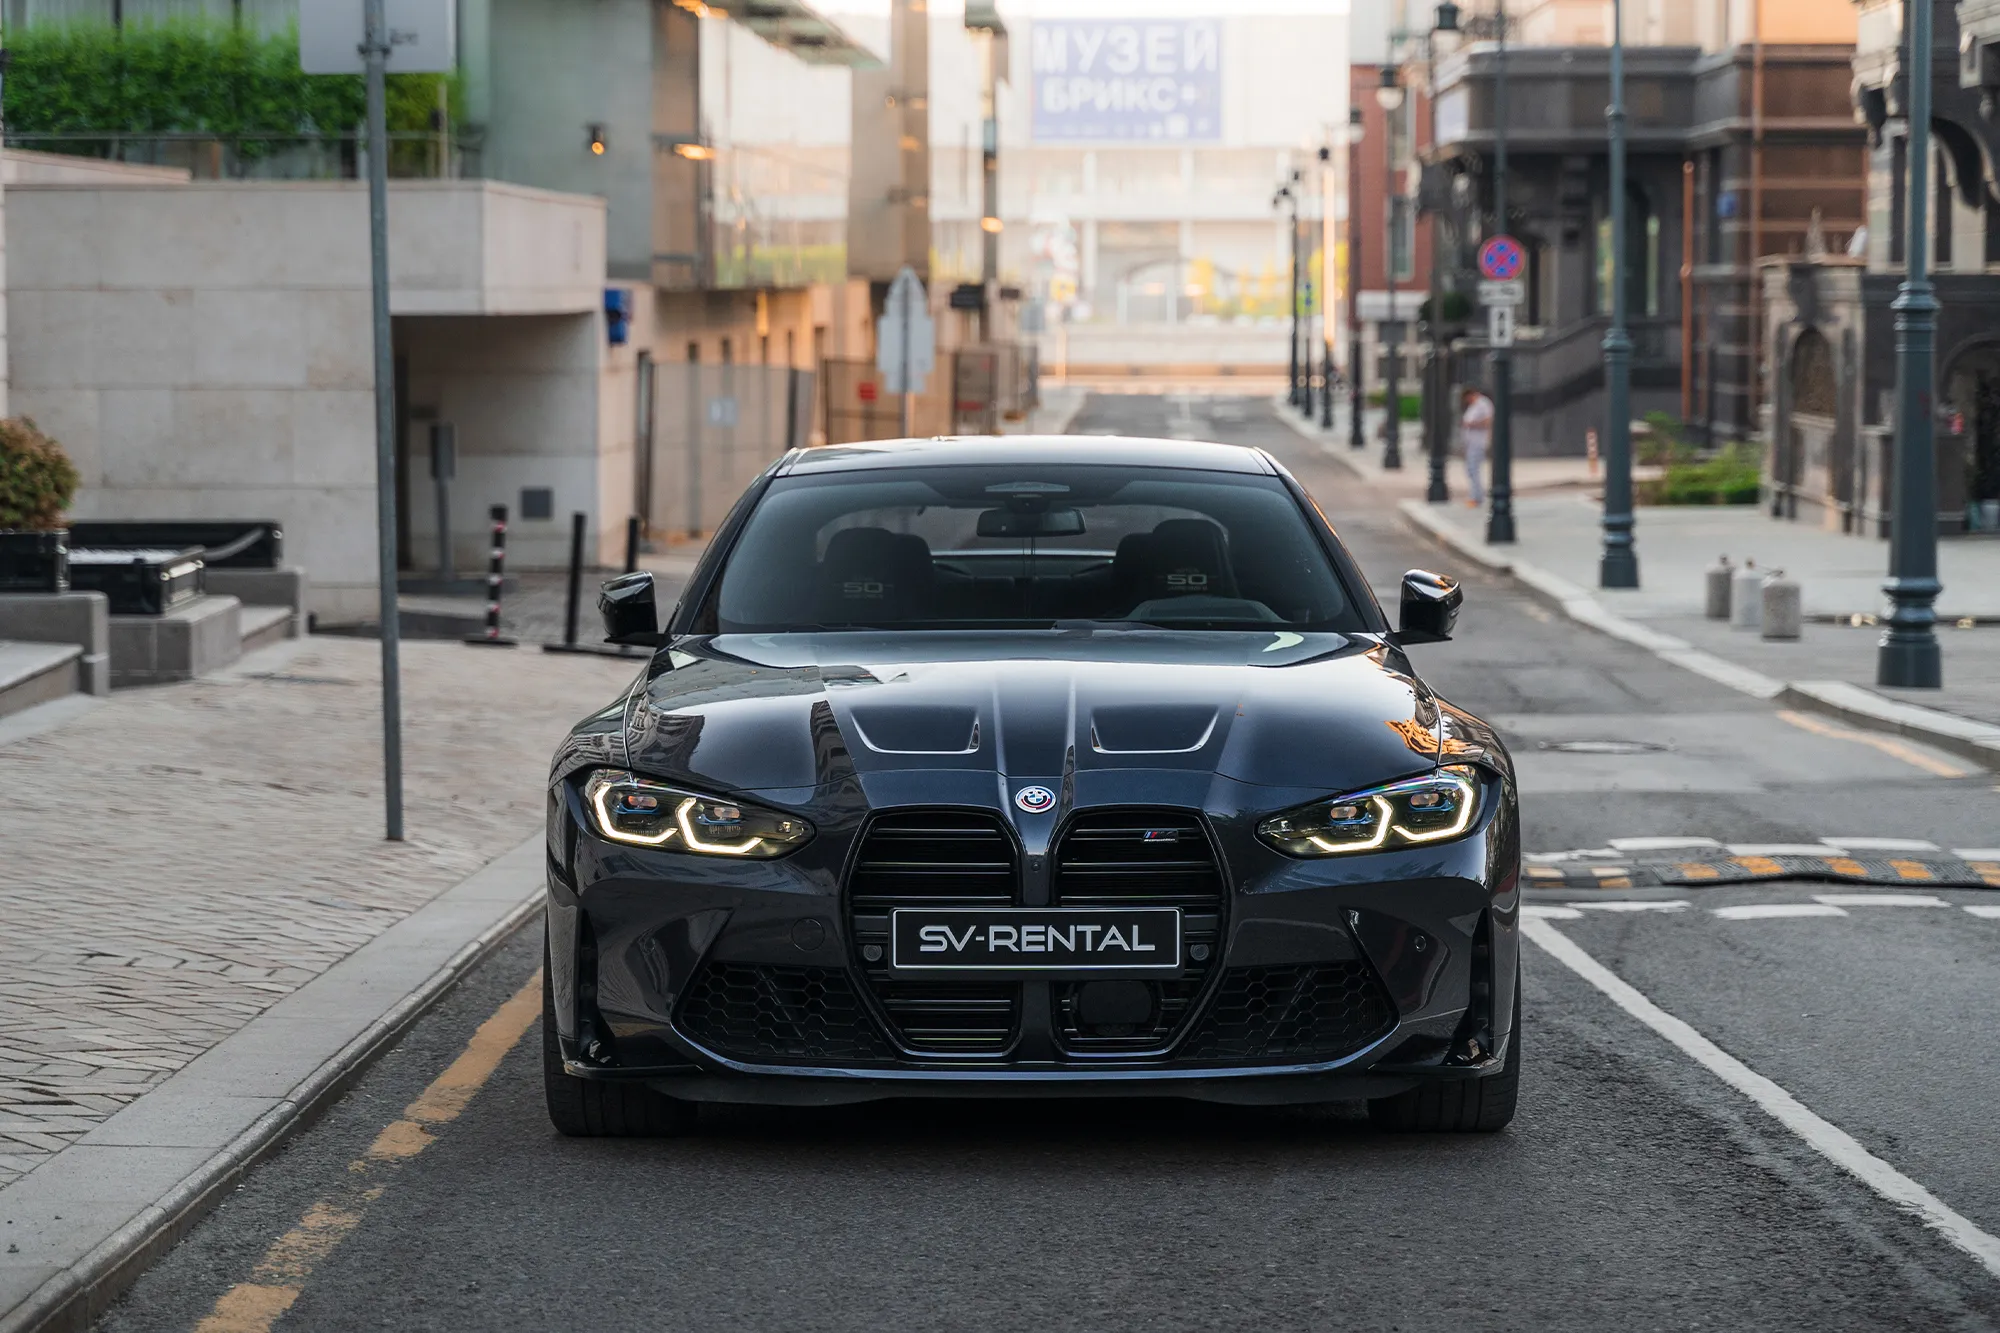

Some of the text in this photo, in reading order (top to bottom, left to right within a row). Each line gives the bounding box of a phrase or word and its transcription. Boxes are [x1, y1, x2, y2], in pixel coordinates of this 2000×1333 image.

[1033, 20, 1217, 74] МУЗЕЙ
[1167, 574, 1207, 584] 50
[919, 925, 1155, 952] SV-RENTAL
